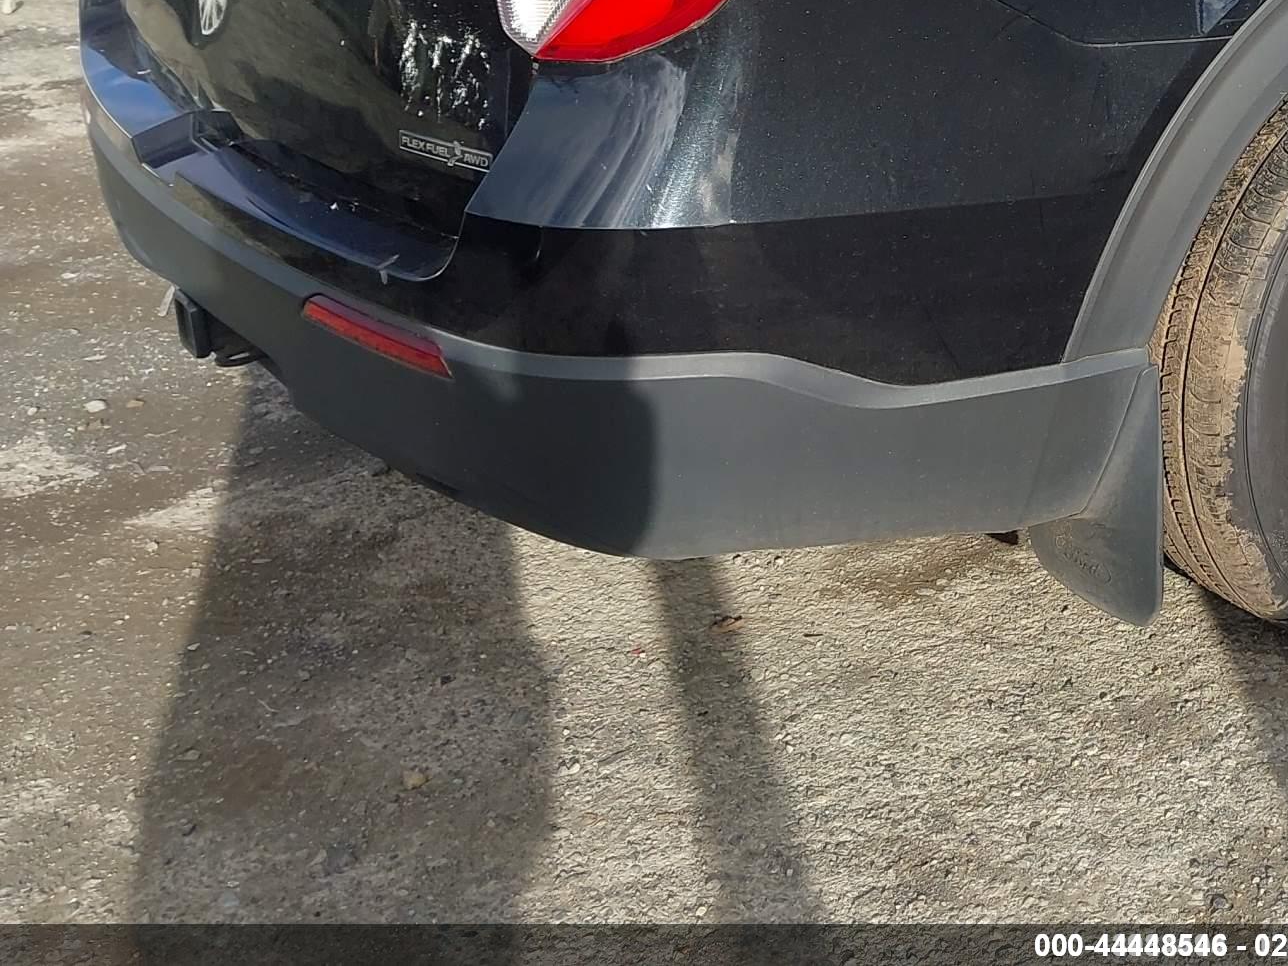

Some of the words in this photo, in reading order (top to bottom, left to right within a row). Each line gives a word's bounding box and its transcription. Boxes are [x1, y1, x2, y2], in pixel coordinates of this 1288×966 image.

[402, 136, 425, 150] FLEX
[426, 143, 451, 157] FUEL
[464, 153, 488, 167] AWD
